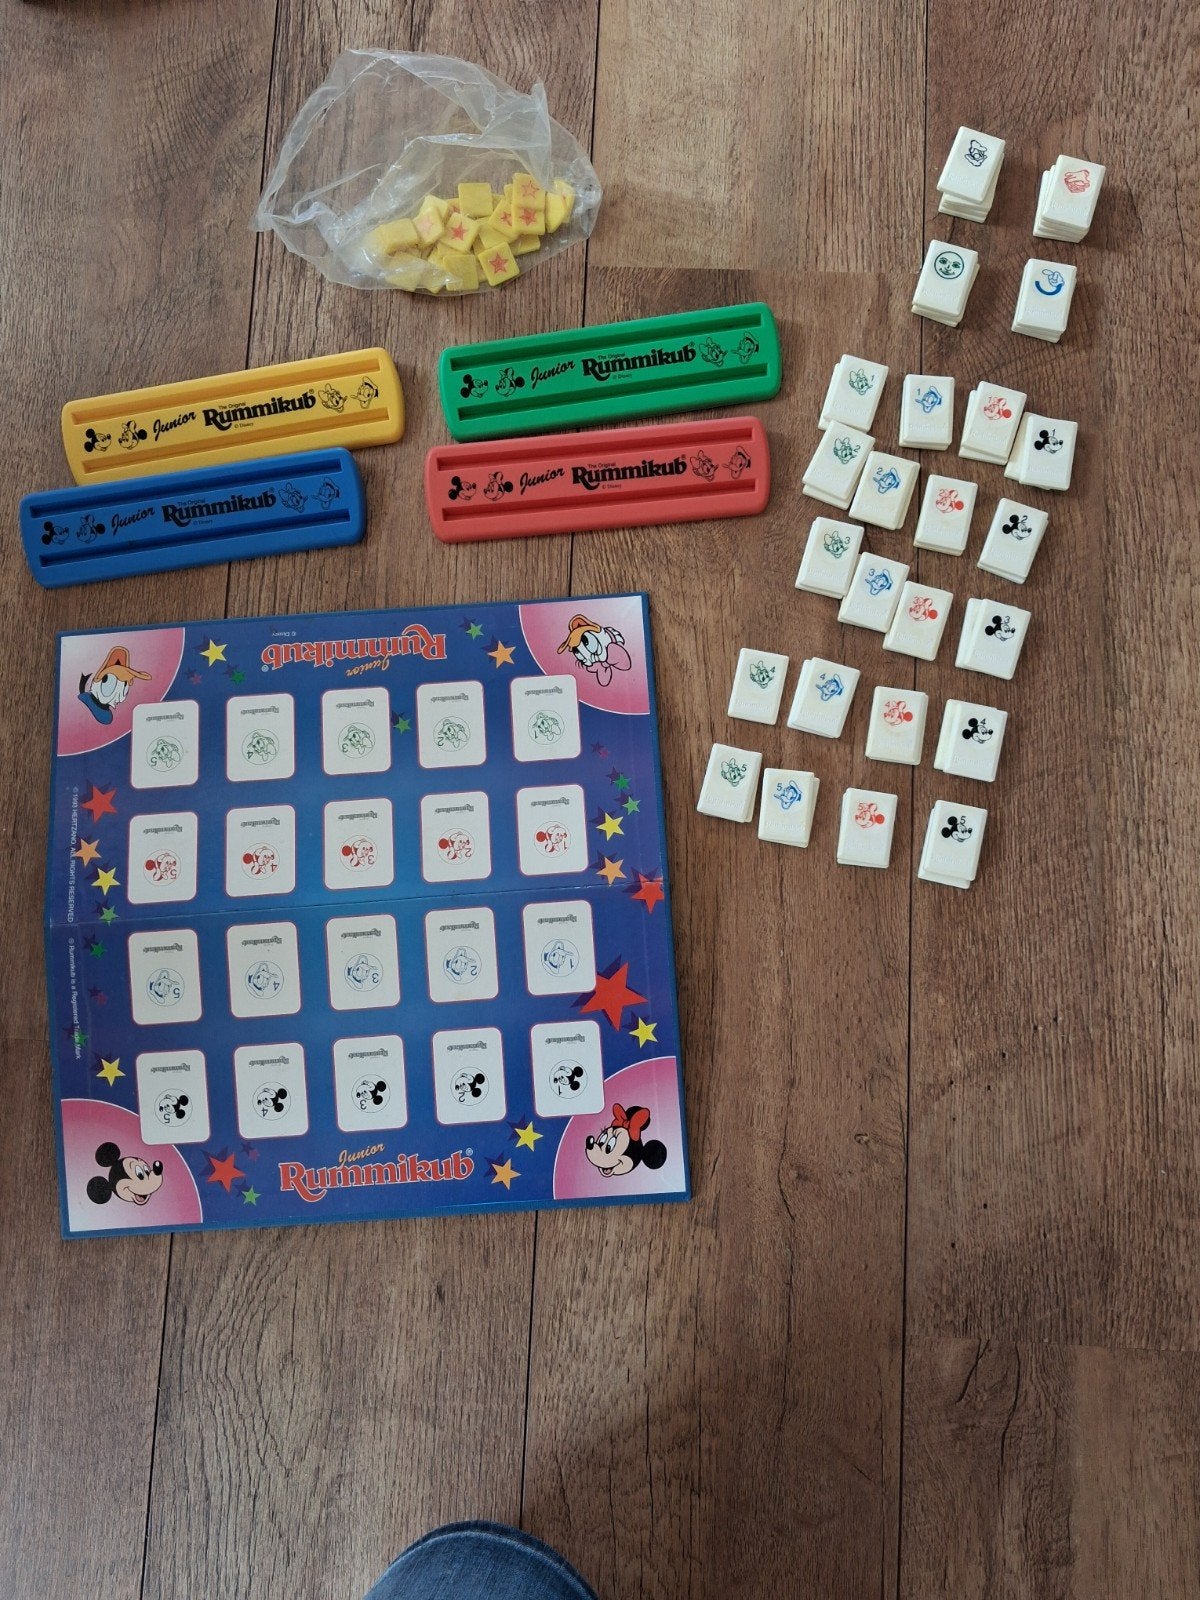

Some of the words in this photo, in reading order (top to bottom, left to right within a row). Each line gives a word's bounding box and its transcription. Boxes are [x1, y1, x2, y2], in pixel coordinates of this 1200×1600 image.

[531, 359, 576, 390] Junior
[153, 411, 196, 441] Junior
[853, 444, 861, 453] 2
[876, 467, 883, 475] 2
[520, 467, 566, 496] Junior
[111, 507, 156, 536] Junior
[1020, 515, 1028, 523] 2
[845, 536, 850, 545] 3
[869, 568, 875, 576] 3
[1004, 616, 1010, 624] 3
[346, 654, 390, 678] Junior
[437, 737, 444, 746] 2
[341, 743, 349, 753] 3
[247, 751, 254, 759] 4
[150, 756, 157, 766] 5
[741, 764, 747, 772] 5
[777, 783, 783, 791] 5
[960, 816, 966, 825] 5
[464, 848, 471, 857] 2
[367, 854, 375, 865] 3
[270, 863, 278, 872] 4
[170, 868, 177, 879] 5
[67, 886, 75, 923] RESERVED
[470, 965, 477, 976] 2
[372, 972, 379, 983] 3
[272, 981, 280, 991] 4
[173, 987, 180, 998] 5
[70, 991, 79, 1024] Registered
[458, 1092, 465, 1102] 2
[360, 1099, 367, 1110] 3
[261, 1107, 269, 1117] 4
[163, 1113, 171, 1123] 5
[338, 1142, 385, 1168] Junior
